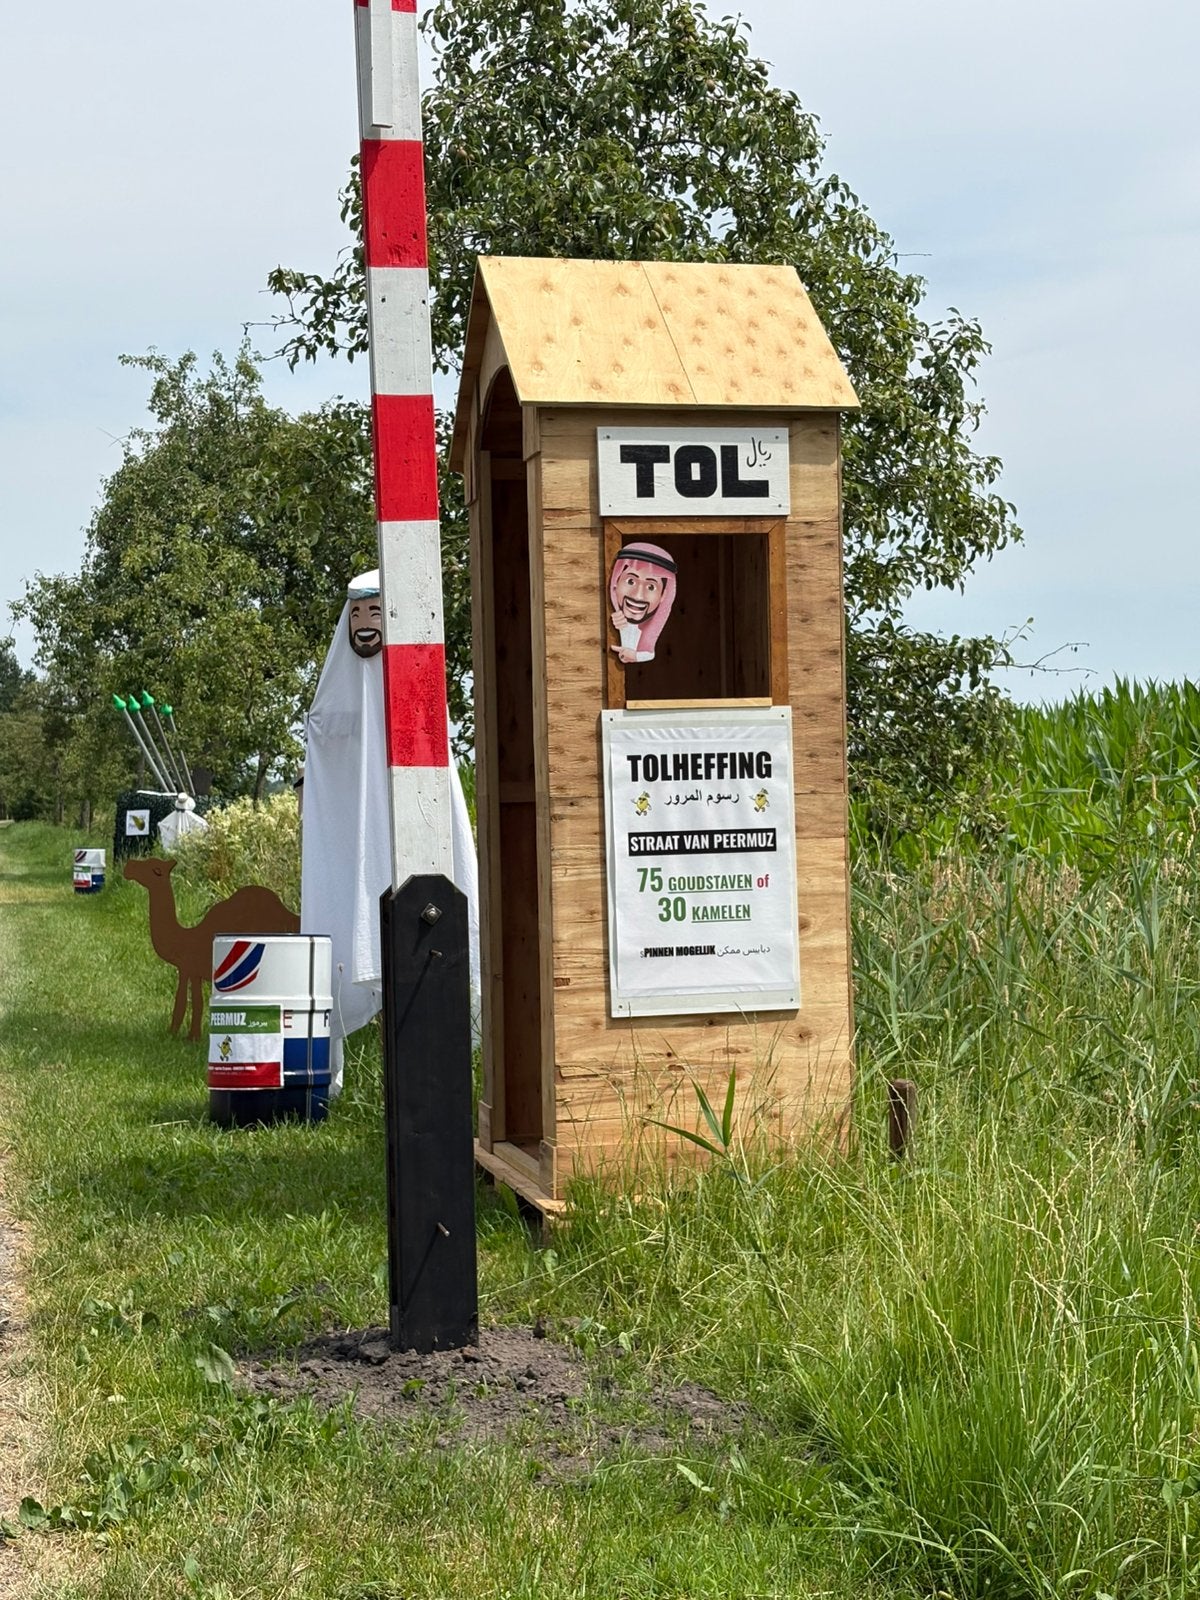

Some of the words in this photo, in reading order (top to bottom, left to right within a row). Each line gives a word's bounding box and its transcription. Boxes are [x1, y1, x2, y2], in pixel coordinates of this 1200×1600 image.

[620, 445, 769, 498] TOL
[627, 751, 772, 782] TOLHEFFING
[664, 789, 702, 805] المرور
[707, 793, 740, 806] رسوم
[630, 835, 680, 852] STRAAT
[683, 834, 710, 850] VAN
[713, 832, 774, 849] PEERMUZ
[637, 867, 663, 893] 75
[668, 874, 753, 891] GOUDSTAVEN
[757, 874, 770, 888] of
[658, 896, 687, 922] 30
[691, 904, 751, 921] KAMELEN
[210, 1012, 247, 1026] PEERMUZ
